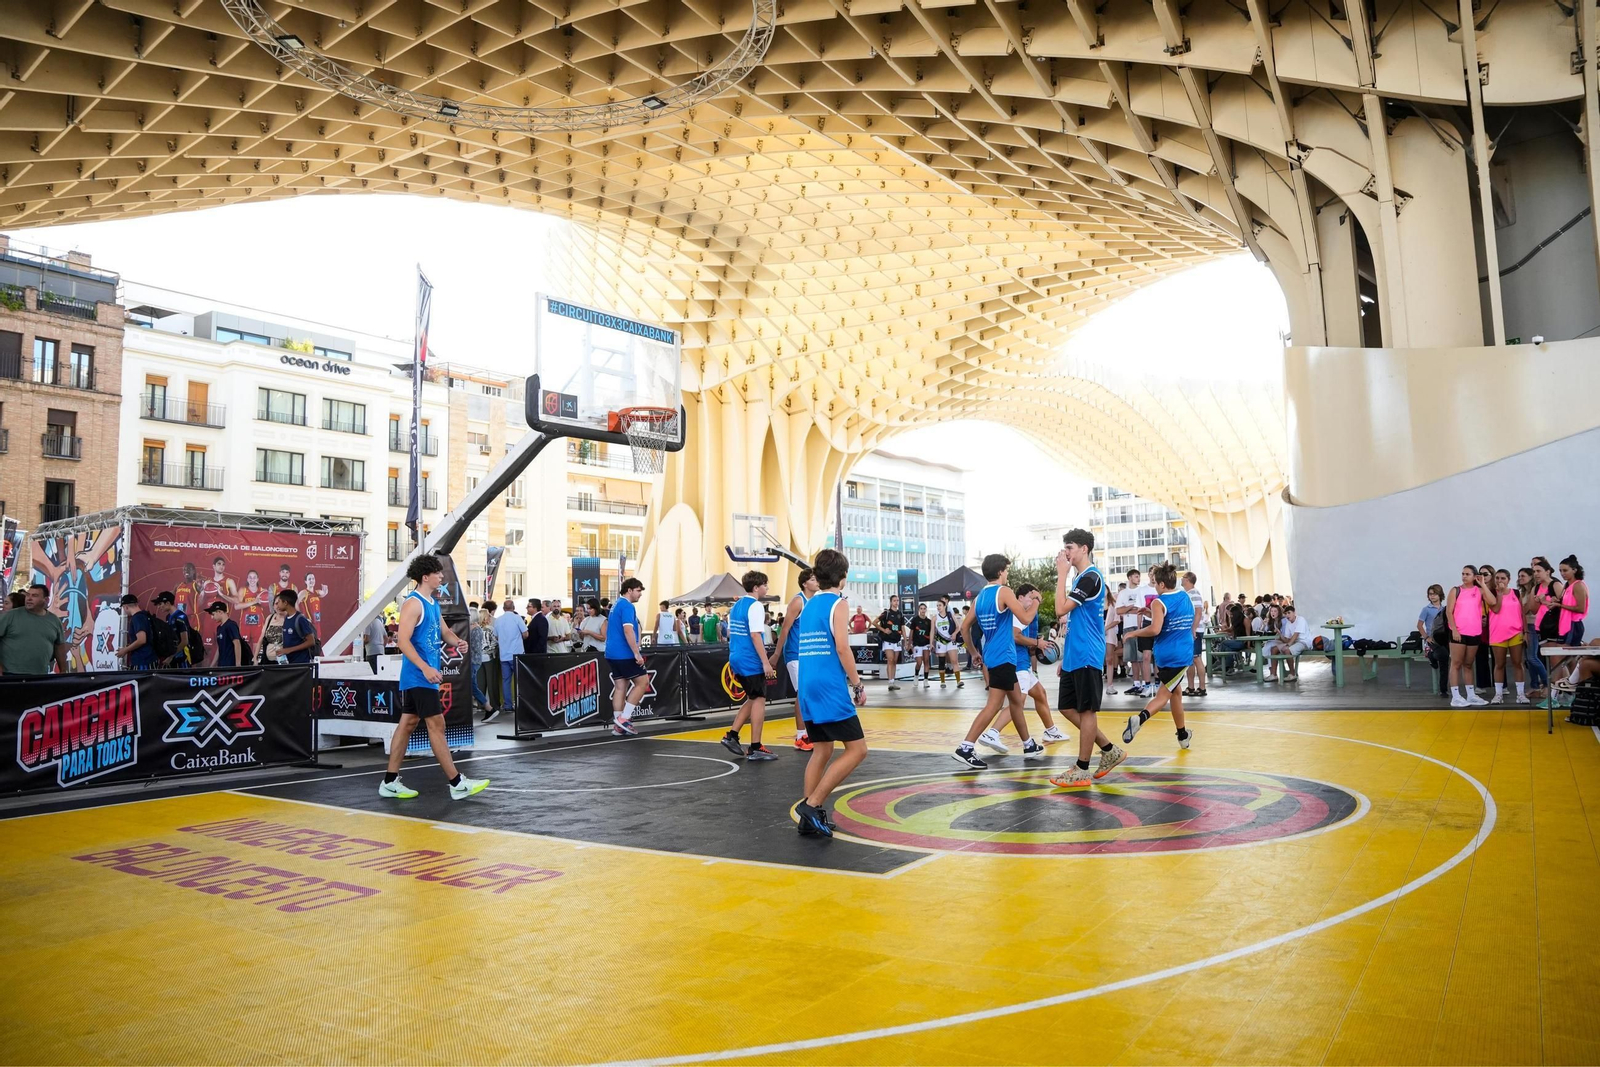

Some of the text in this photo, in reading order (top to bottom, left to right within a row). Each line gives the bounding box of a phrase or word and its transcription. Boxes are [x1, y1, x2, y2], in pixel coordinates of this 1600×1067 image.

[550, 301, 673, 344] #CIRCUITO3X3CAIXABANK
[280, 355, 351, 375] ocean drive
[154, 540, 197, 549] SELECCIÓN
[199, 542, 239, 550] ESPAÑOLA
[251, 545, 298, 553] BALONCESTO
[439, 666, 461, 675] aBank
[189, 675, 244, 688] CIRCUITO
[549, 661, 597, 711] CANCHA
[566, 701, 580, 722] PARA
[631, 705, 654, 717] aBank
[21, 684, 135, 766] CANCHA
[61, 737, 132, 780] PARA TODXS
[170, 746, 257, 771] CaixaBank
